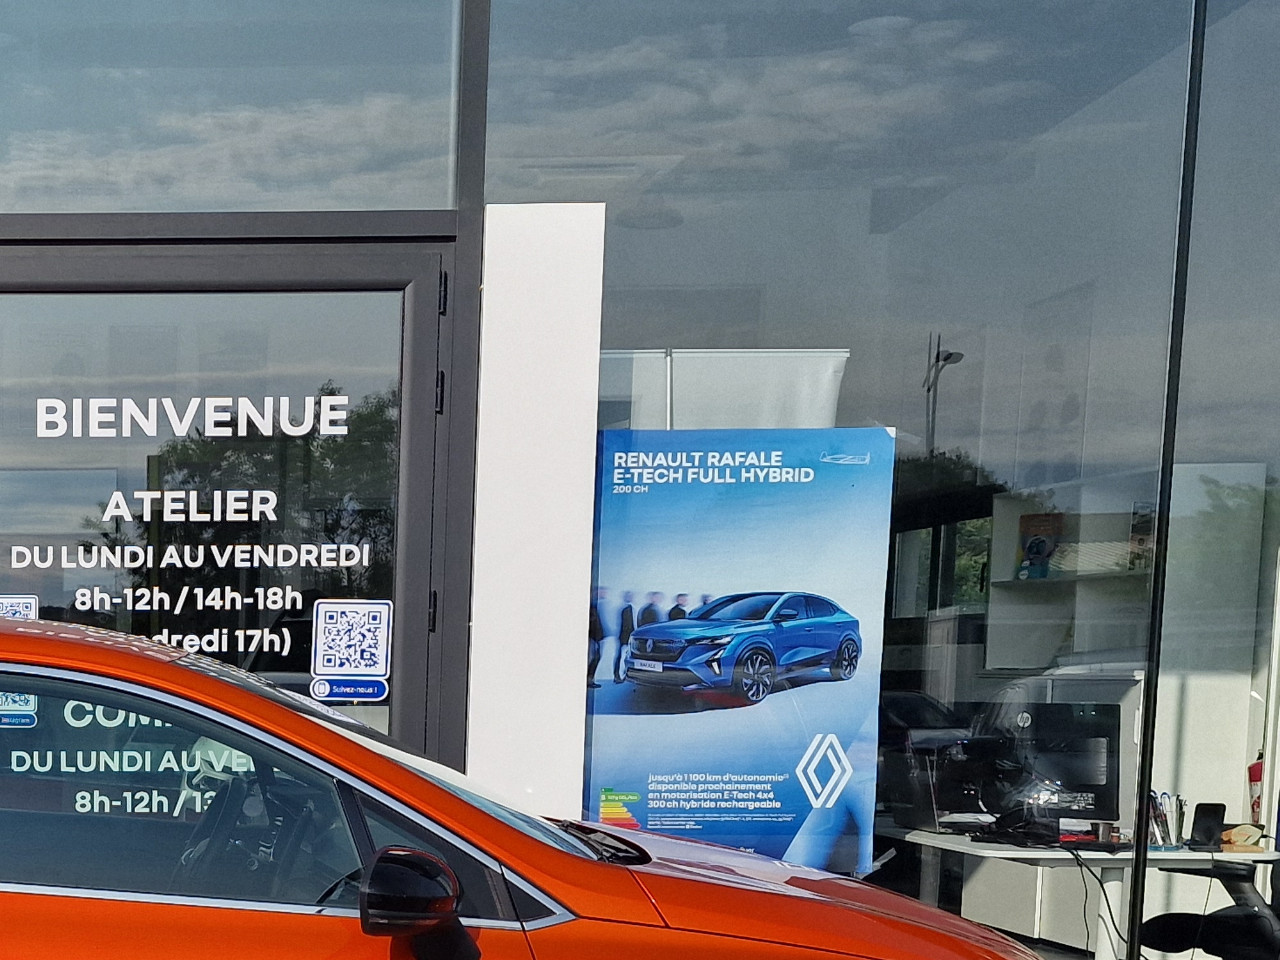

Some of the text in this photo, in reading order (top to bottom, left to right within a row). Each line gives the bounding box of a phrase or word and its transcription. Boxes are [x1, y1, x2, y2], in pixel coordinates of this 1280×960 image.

[36, 395, 349, 438] BIENVENUE
[613, 451, 783, 467] RENAULT RAFALE
[613, 467, 815, 484] E-TECH FULL HYBRID
[613, 485, 649, 493] 200 CH
[102, 490, 278, 522] ATELIER
[11, 544, 369, 568] DU LUNDI AU VENDREDI
[74, 586, 303, 615] 8h-12h / 14h-18h
[151, 627, 291, 656] dredi 17h)
[11, 751, 53, 772] DU
[60, 750, 151, 772] LUNDI
[158, 750, 201, 772] AU
[648, 773, 683, 783] jusqu'à
[648, 782, 772, 792] disponible prochainement
[75, 790, 169, 813] 8h-12h
[172, 791, 187, 816] /
[661, 791, 723, 799] motorisation
[723, 791, 755, 799] E-Tech
[756, 791, 775, 799] 4x4
[647, 800, 781, 810] 300 ch hybride rechargeable
